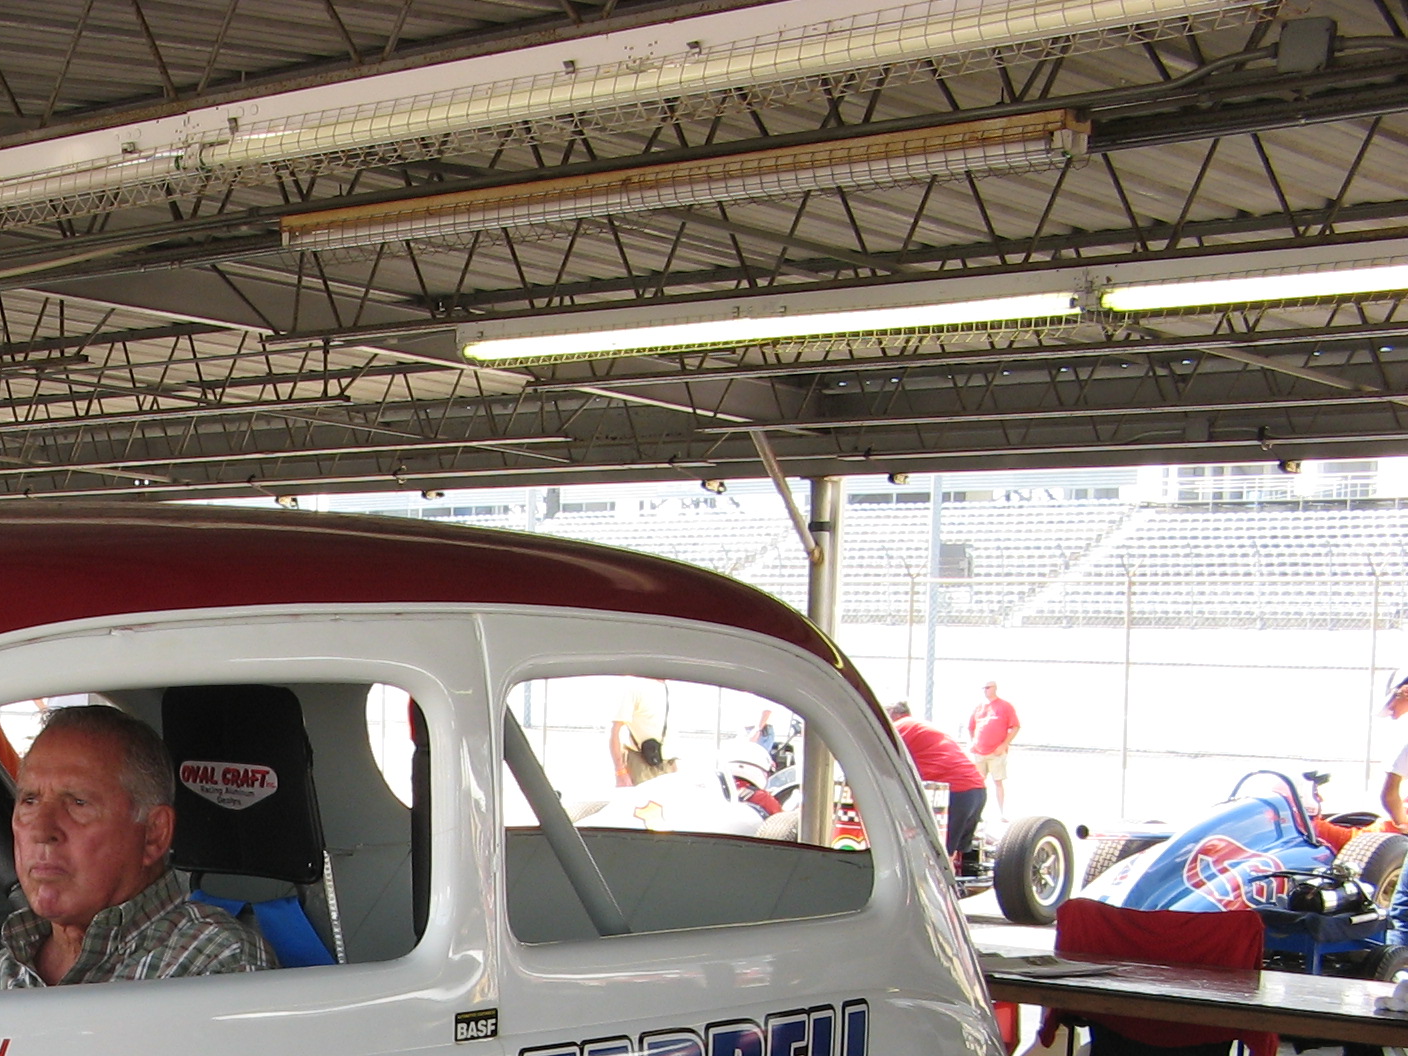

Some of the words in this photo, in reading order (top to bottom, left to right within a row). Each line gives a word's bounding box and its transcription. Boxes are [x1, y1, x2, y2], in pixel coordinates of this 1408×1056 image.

[181, 764, 218, 786] OVAL
[221, 767, 270, 789] CRAFT
[456, 1018, 497, 1040] BASF
